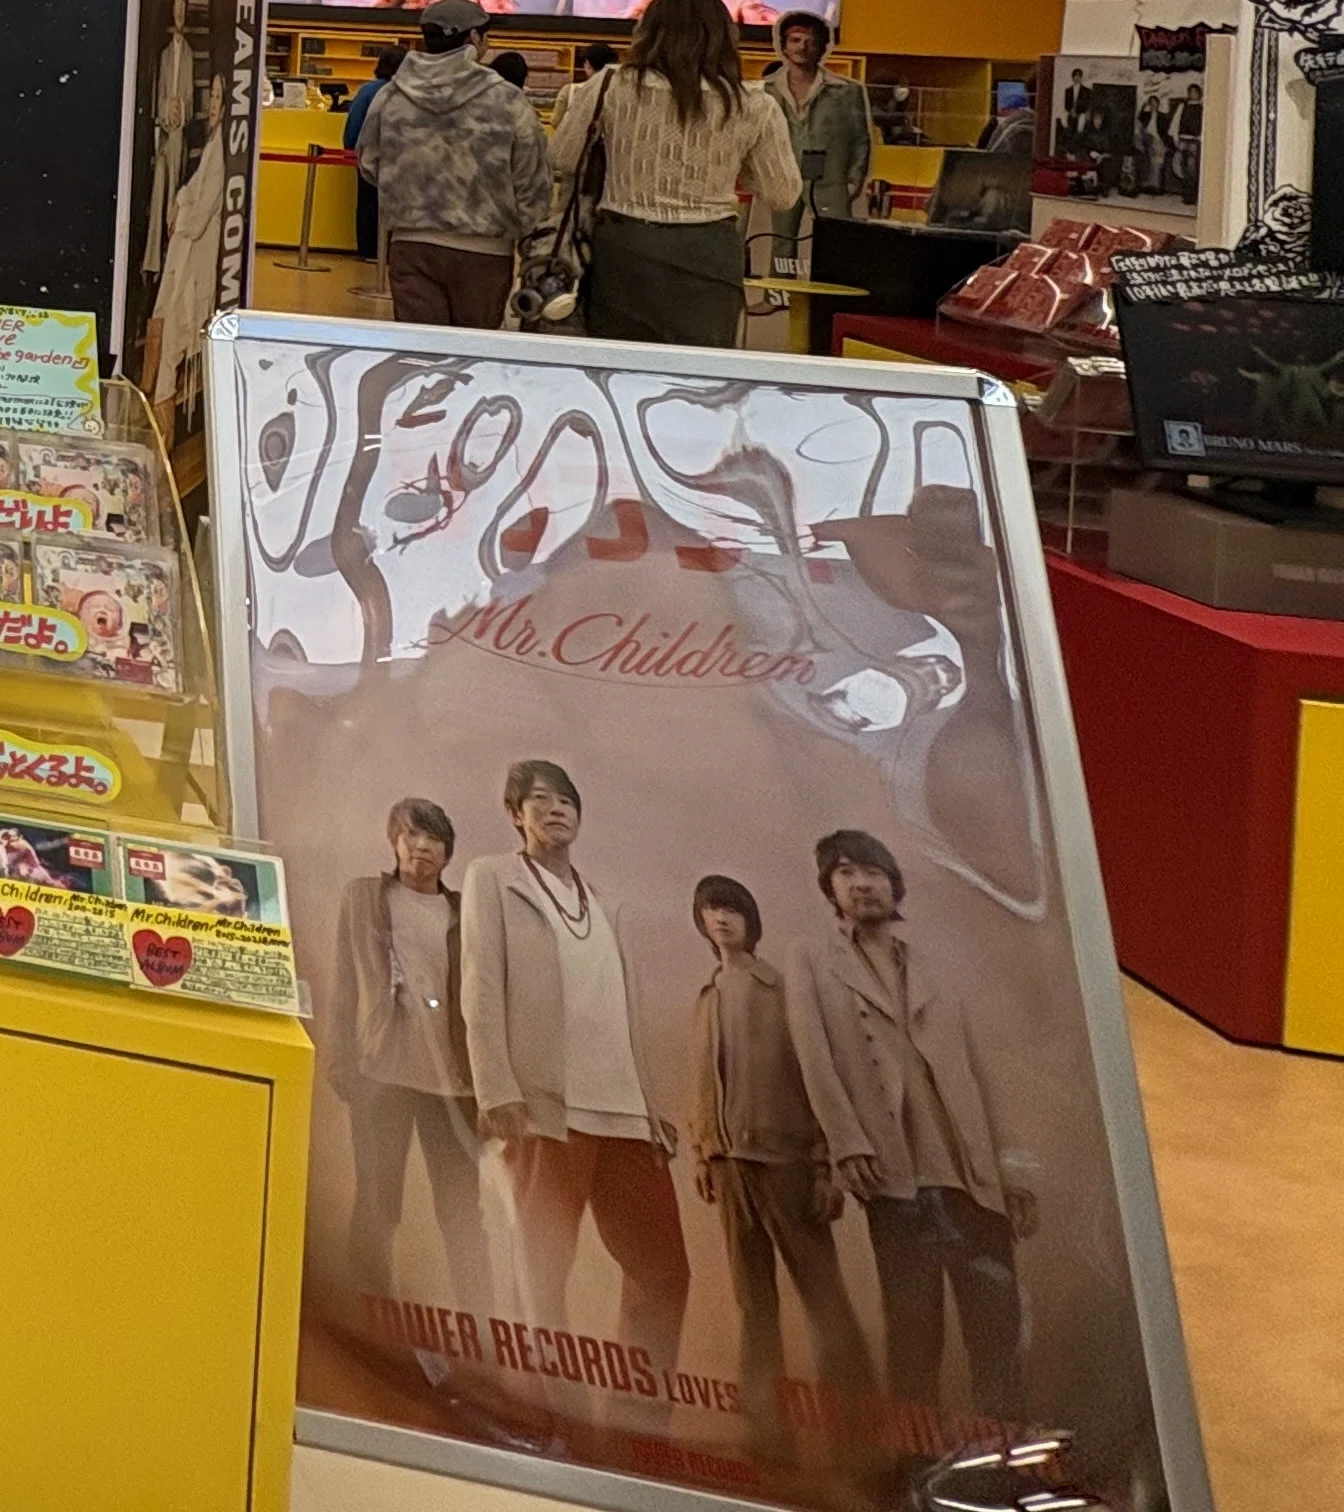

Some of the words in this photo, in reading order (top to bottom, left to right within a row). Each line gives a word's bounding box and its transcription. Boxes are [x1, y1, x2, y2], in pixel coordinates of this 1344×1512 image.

[1258, 441, 1304, 454] MARS
[488, 1316, 660, 1398] RECORDS
[662, 1366, 743, 1416] LOVES
